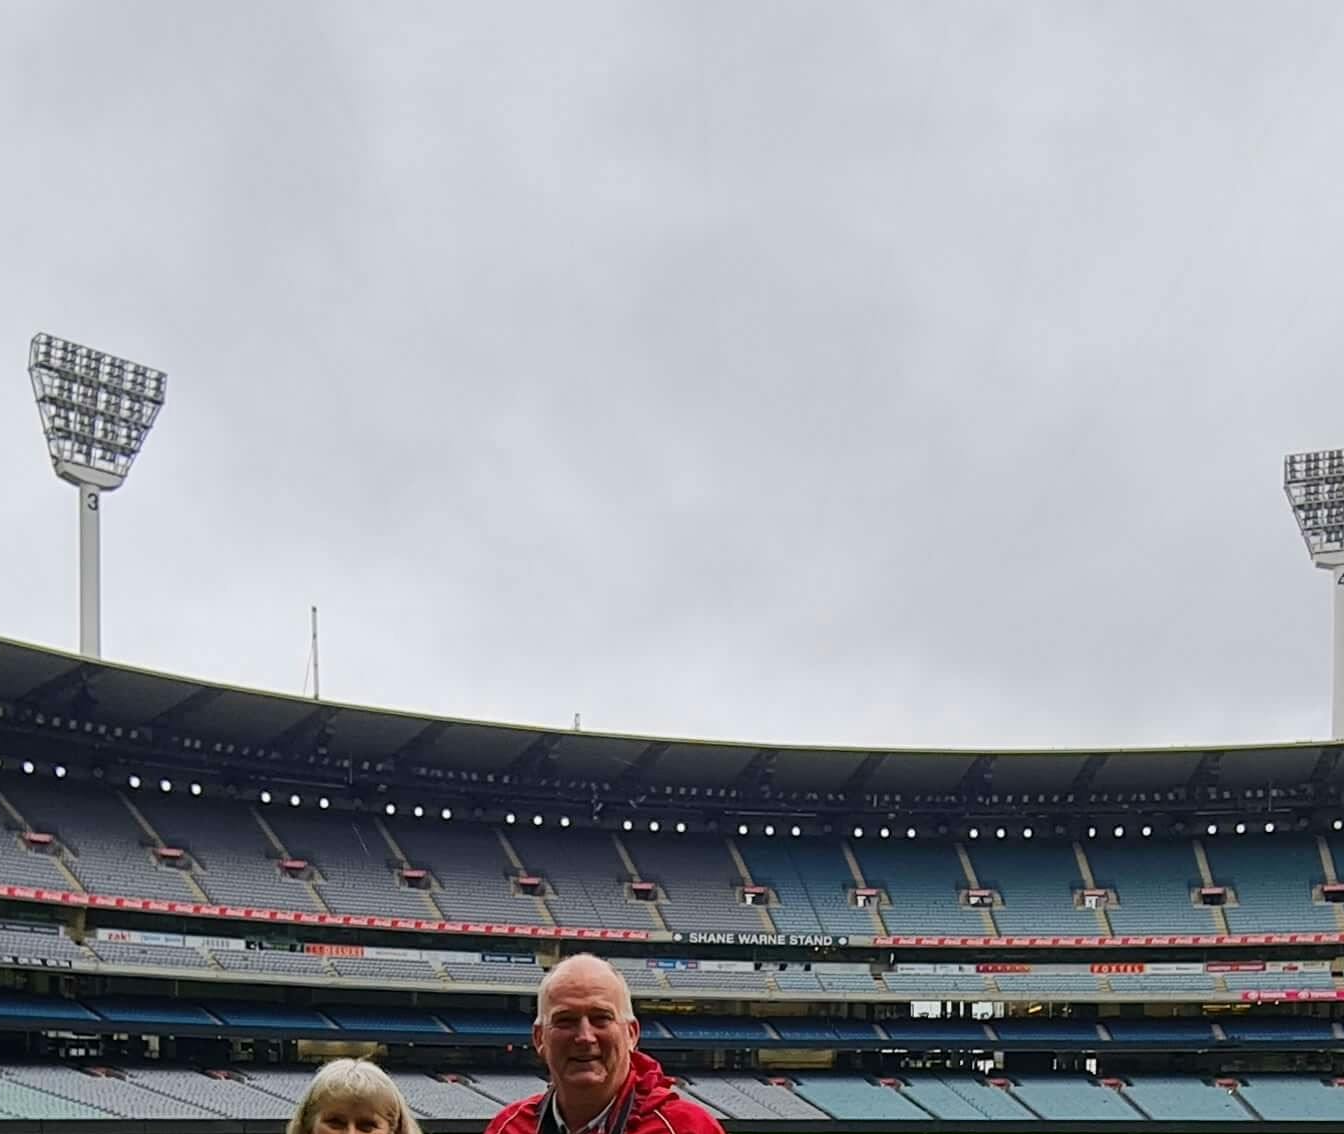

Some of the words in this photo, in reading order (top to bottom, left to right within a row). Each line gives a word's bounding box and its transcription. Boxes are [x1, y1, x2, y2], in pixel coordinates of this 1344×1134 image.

[87, 491, 100, 511] 3
[689, 933, 735, 944] SHANE
[739, 934, 786, 945] WARNE
[789, 935, 833, 946] STAND
